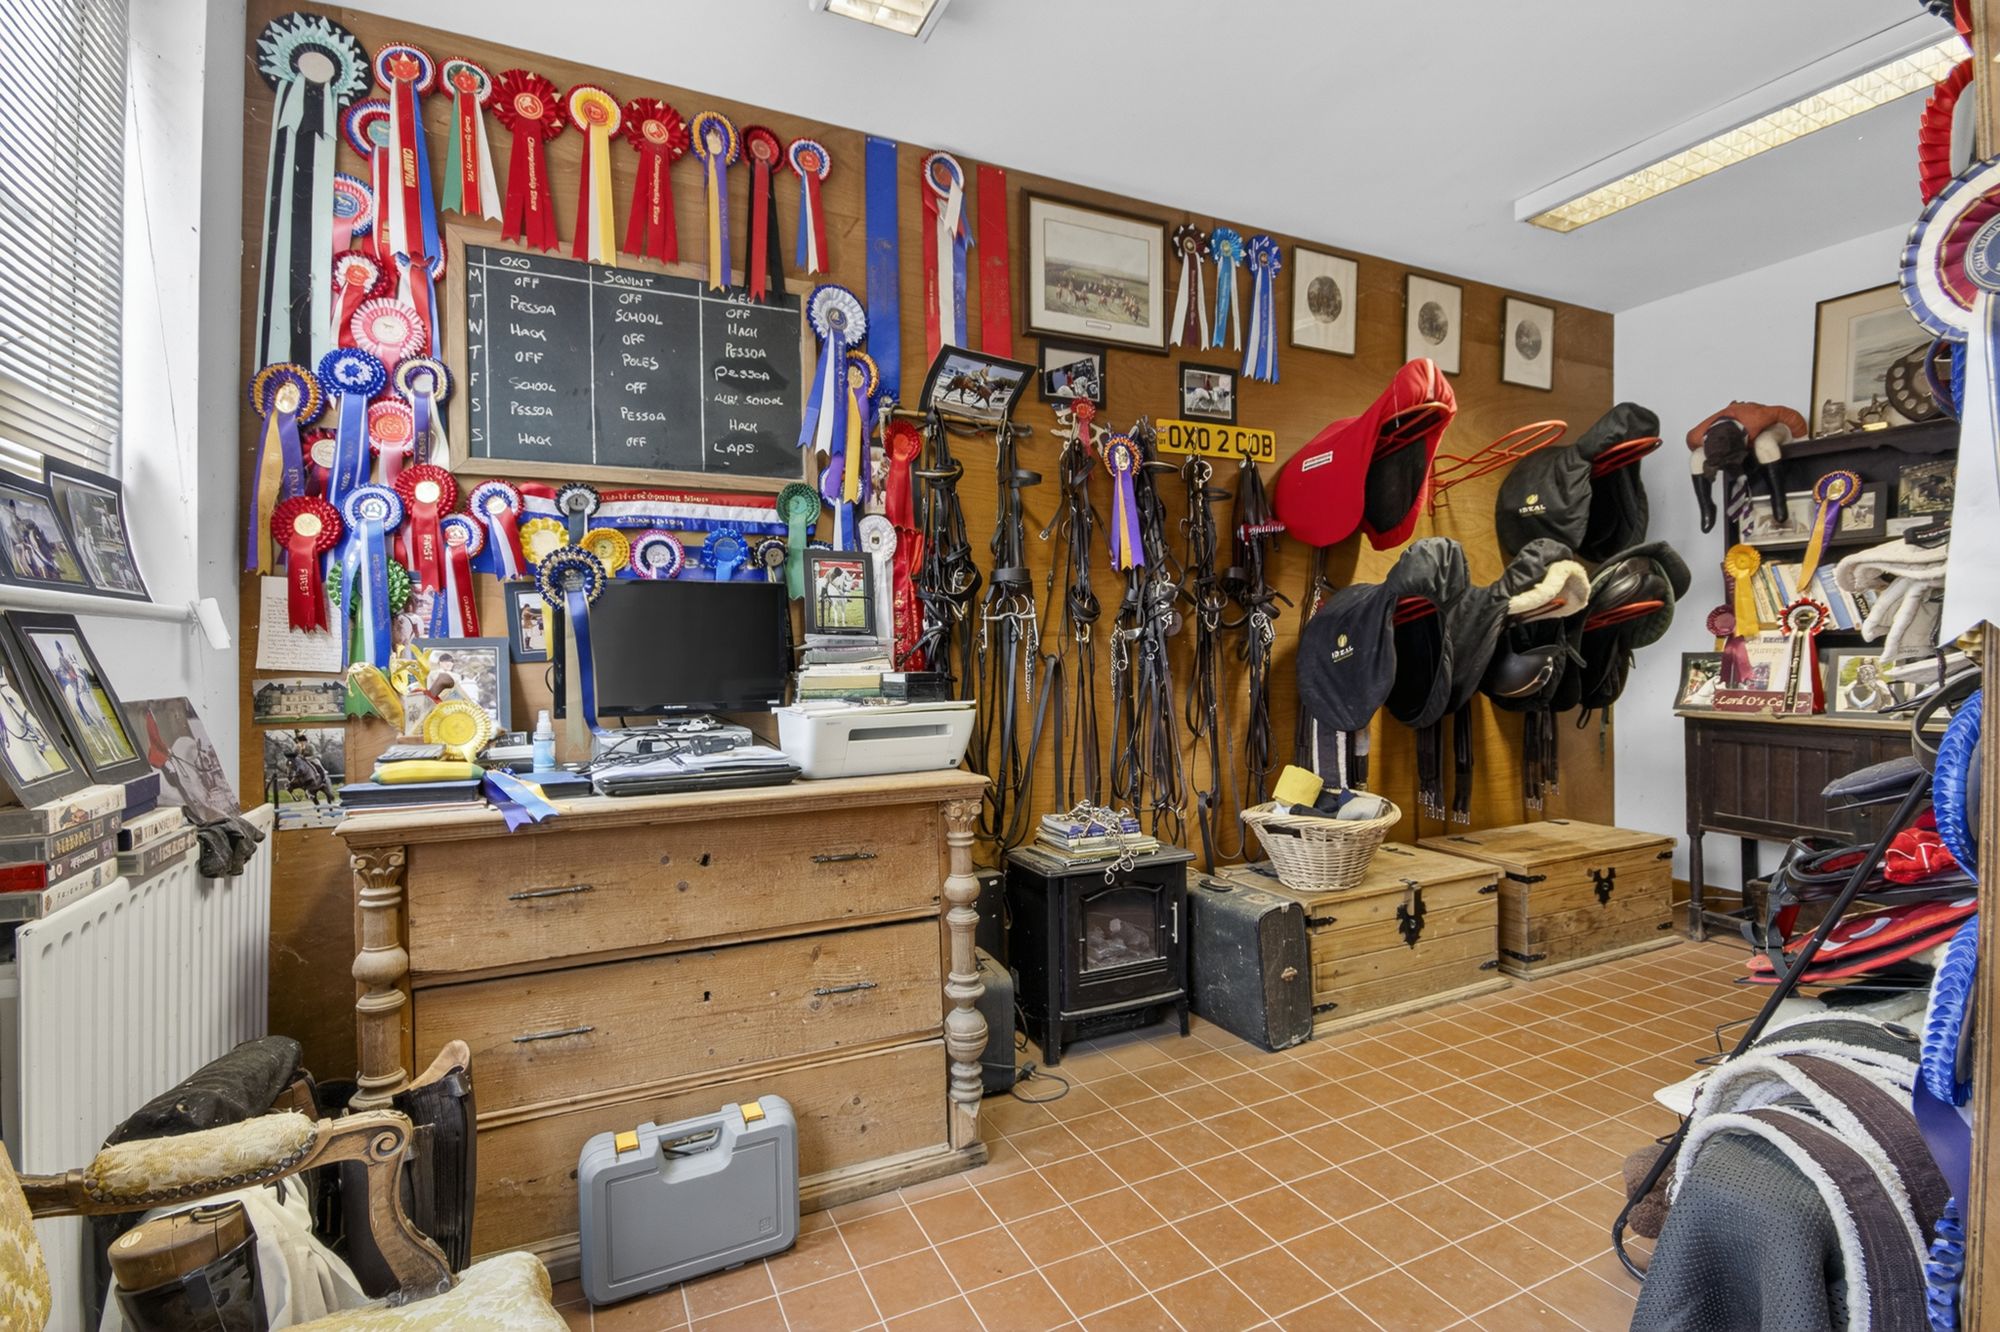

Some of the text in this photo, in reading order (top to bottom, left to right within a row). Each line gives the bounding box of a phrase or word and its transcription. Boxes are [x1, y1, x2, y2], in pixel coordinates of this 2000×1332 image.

[528, 136, 538, 212] Championship Show
[652, 154, 662, 225] Championship Show
[468, 269, 482, 284] M
[514, 277, 540, 288] OFF
[469, 294, 482, 308] T
[618, 294, 642, 304] OFF
[615, 308, 663, 325] SCHOOL
[726, 308, 751, 320] OFF
[468, 319, 483, 336] W
[622, 333, 646, 345] OFF
[469, 345, 482, 360] T
[515, 352, 544, 364] OFF
[725, 343, 766, 359] PESSOA
[622, 353, 660, 370] POLES
[470, 372, 480, 386] F
[508, 377, 556, 392] SCHOOL
[625, 382, 648, 394] OFF
[472, 398, 482, 412] S
[510, 401, 554, 416] PESSOA
[620, 406, 666, 422] PESSOA
[729, 418, 758, 434] HACK
[472, 428, 484, 442] S
[626, 436, 648, 447] OFF
[1169, 424, 1273, 457] OXO 2 COB
[424, 534, 432, 562] FIRST
[300, 568, 309, 597] FIRST
